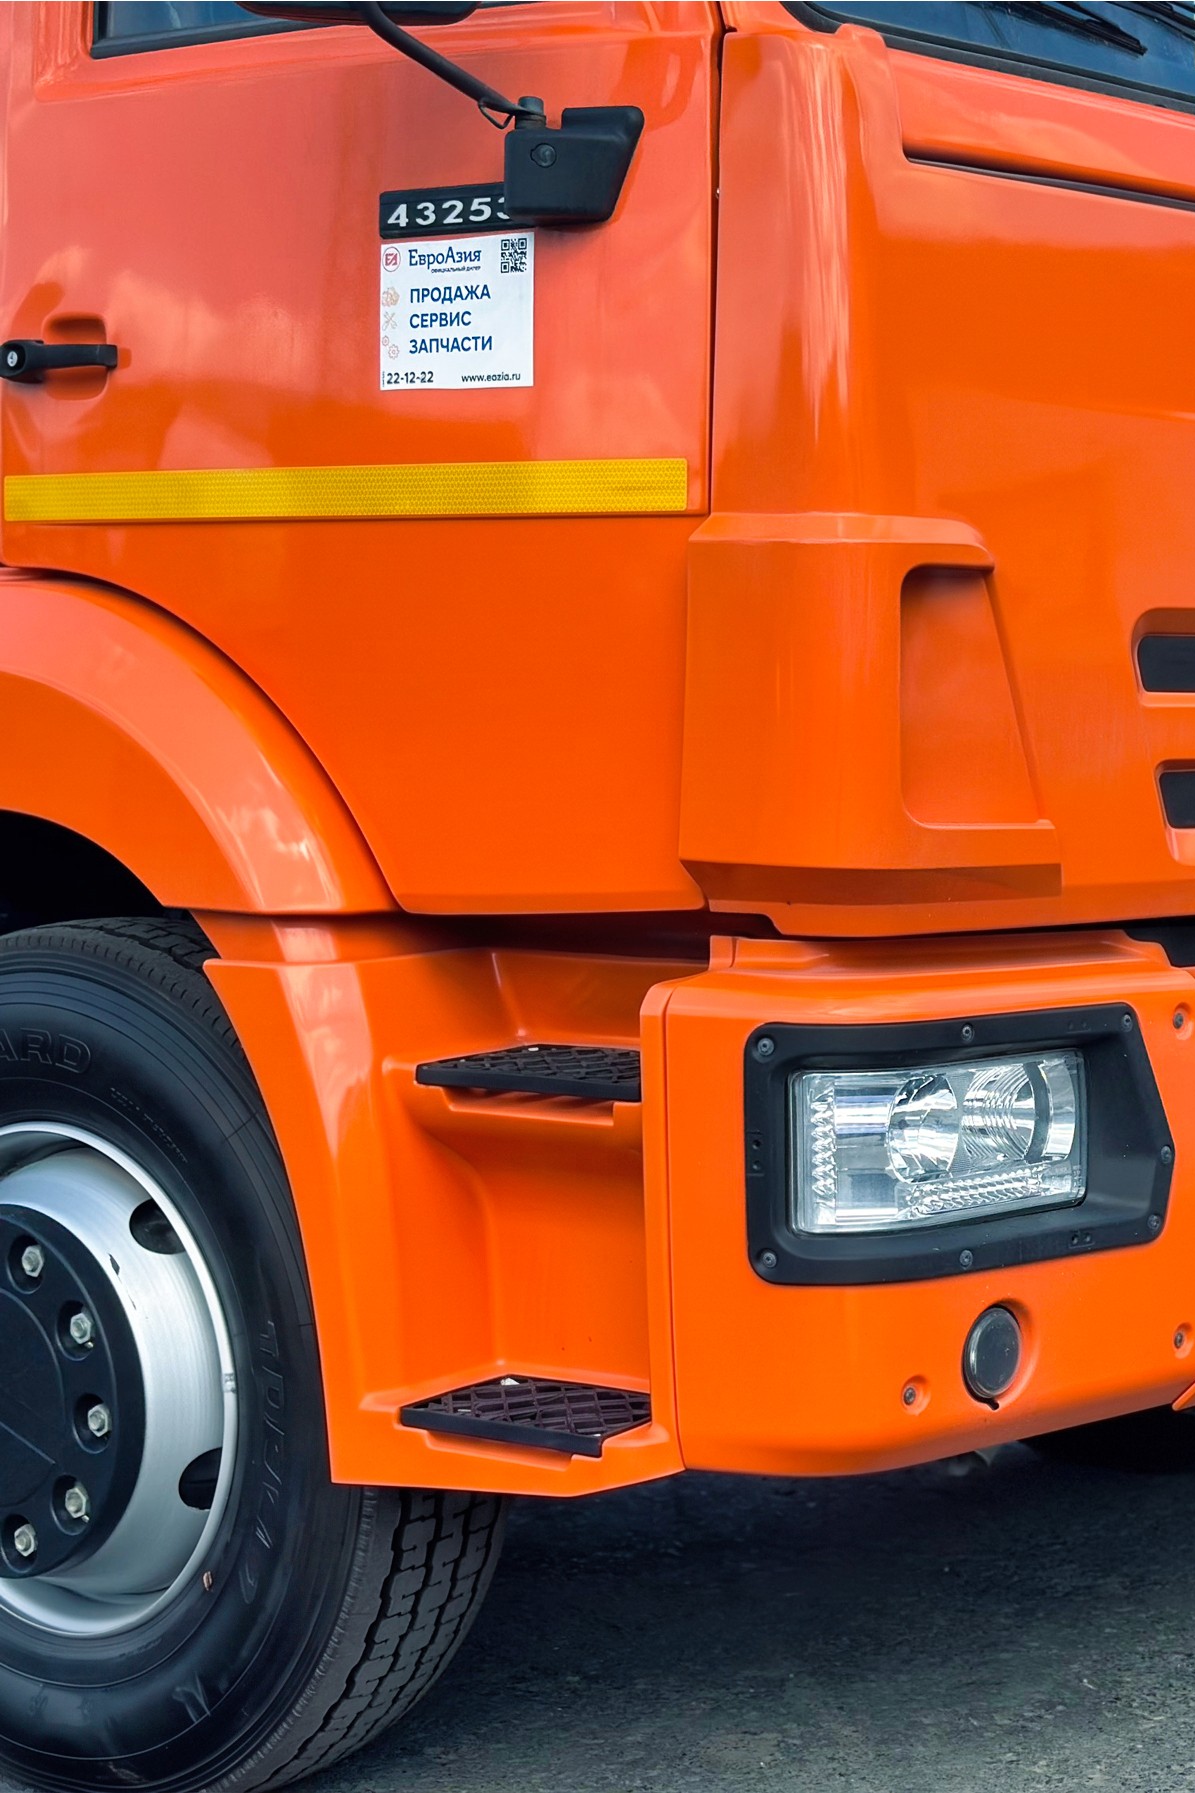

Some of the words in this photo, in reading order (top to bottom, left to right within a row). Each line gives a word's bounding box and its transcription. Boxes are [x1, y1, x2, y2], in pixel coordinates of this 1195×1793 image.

[408, 246, 482, 270] ЕвроАзия
[410, 284, 491, 304] ПРОДАЖА
[409, 311, 472, 329] СЕРВИС
[409, 336, 493, 354] ЗАПЧАСТИ
[386, 371, 434, 385] 22-12-22
[461, 372, 521, 382] www.eazia.ru
